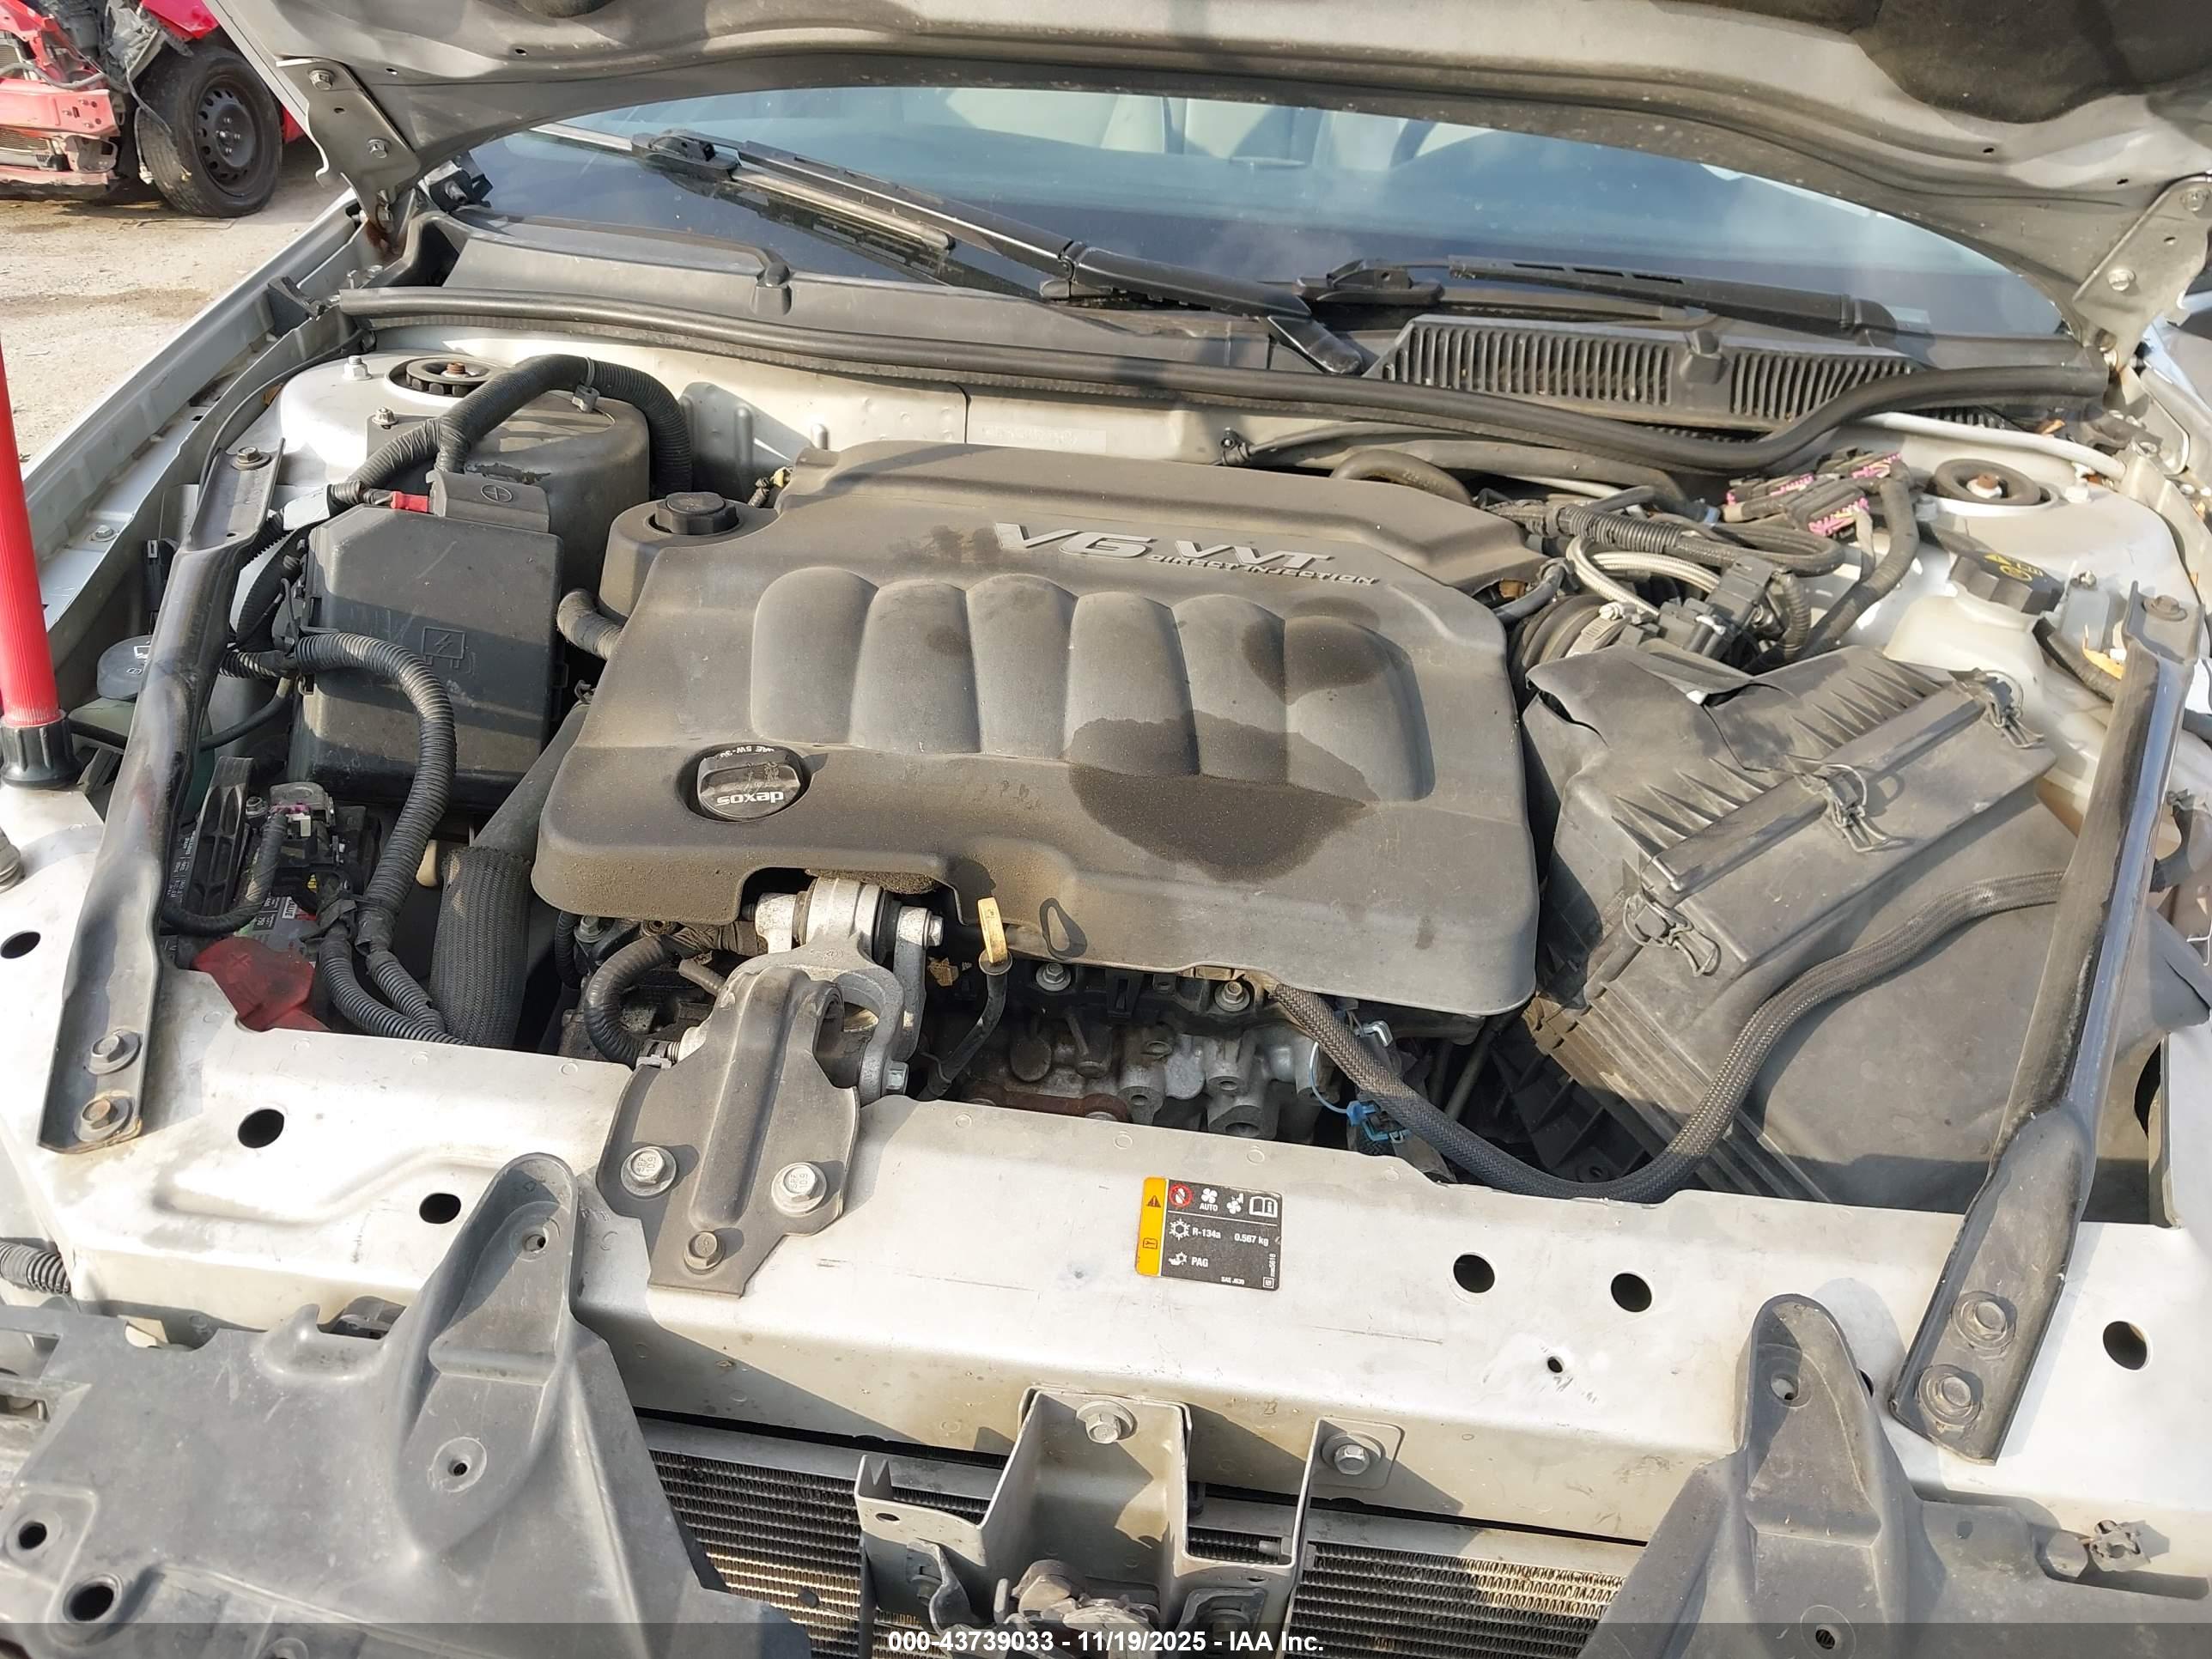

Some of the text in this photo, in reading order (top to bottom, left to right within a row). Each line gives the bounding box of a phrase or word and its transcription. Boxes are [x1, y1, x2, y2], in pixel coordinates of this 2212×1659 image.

[995, 522, 1332, 570] V6 VVT
[1146, 554, 1377, 586] DIRECT INJECTION
[716, 791, 784, 806] dexos
[1200, 1202, 1218, 1212] AUTO
[1192, 1228, 1269, 1247] R-134a 0.567 kg
[1191, 1256, 1209, 1267] PAG
